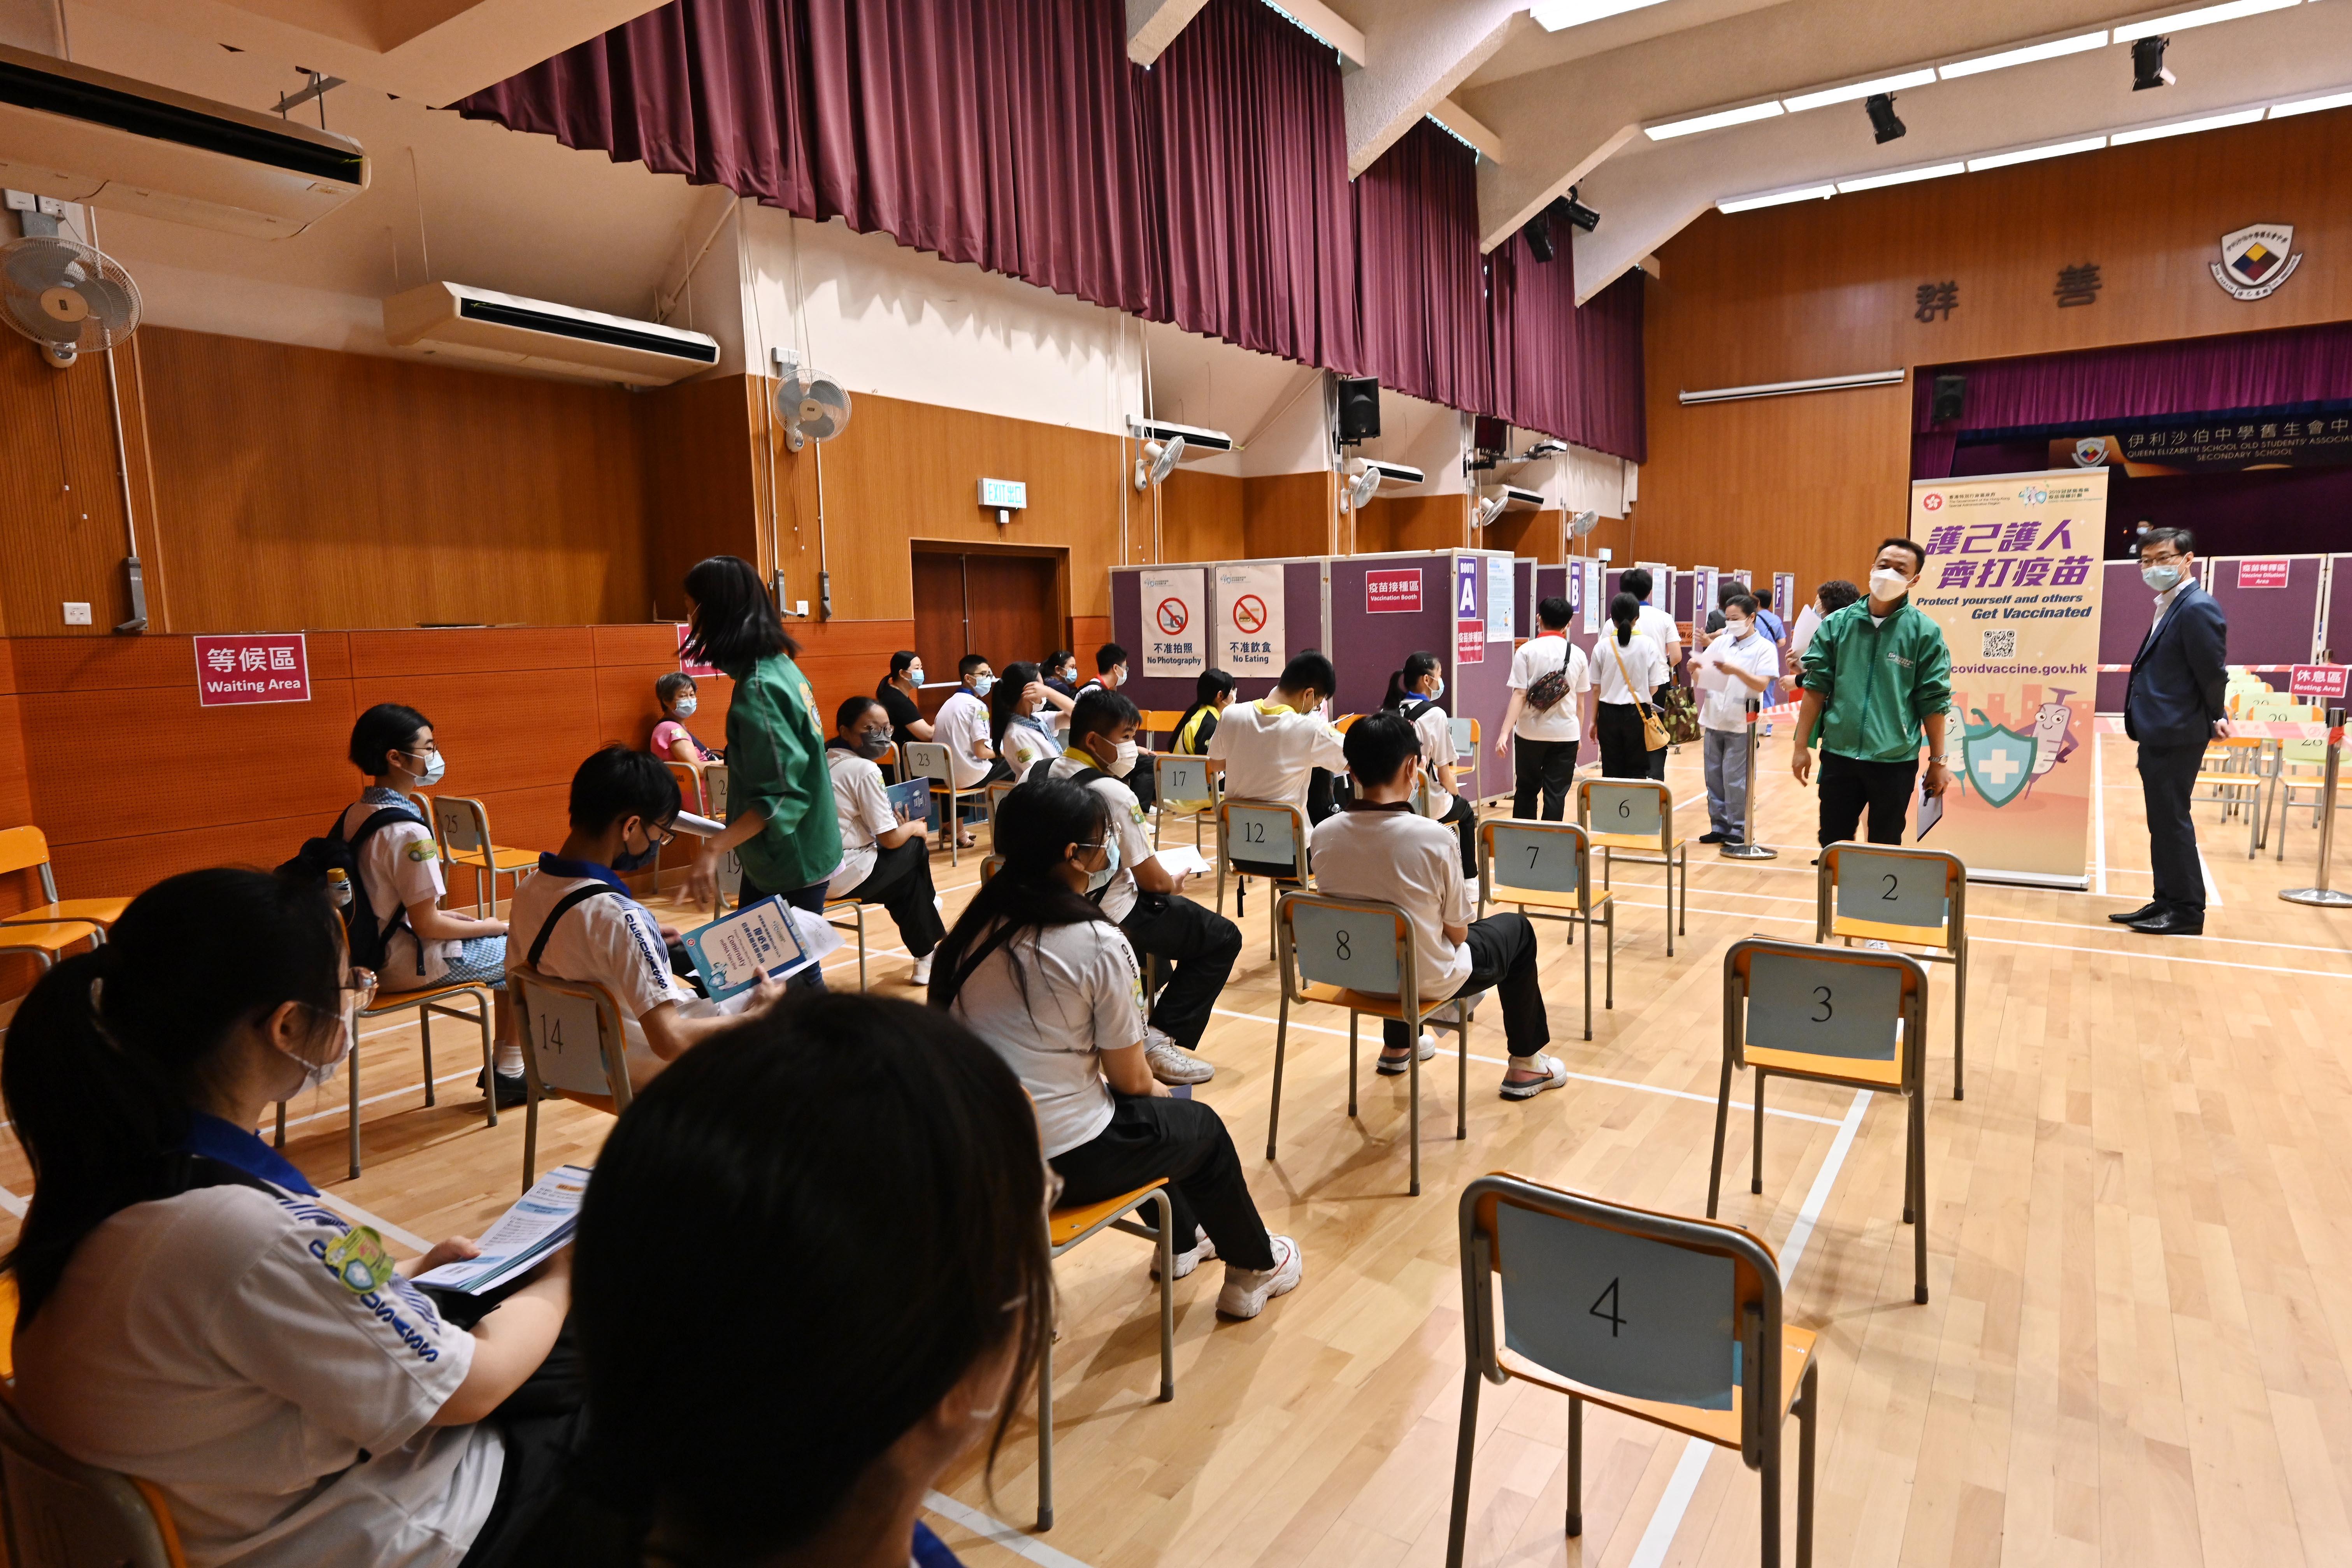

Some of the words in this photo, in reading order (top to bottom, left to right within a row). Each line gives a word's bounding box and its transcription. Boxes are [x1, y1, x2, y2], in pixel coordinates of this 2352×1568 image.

[2127, 449, 2155, 458] QUEEN
[2157, 446, 2199, 456] ELIZABETH
[2201, 443, 2237, 452] SCHOOL
[2197, 451, 2251, 462] SECONDARY
[2254, 448, 2293, 457] SCHOOL
[988, 483, 1006, 502] EXIT
[1007, 485, 1022, 504] 出口
[1925, 519, 2072, 556] 護己護人
[1460, 562, 1474, 574] BOOTH
[1936, 555, 2094, 589] 齊打疫苗
[1368, 580, 1420, 593] 疫苗接種區
[1459, 578, 1475, 611] A
[1571, 578, 1579, 606] B
[1697, 584, 1703, 606] D
[1776, 586, 1781, 604] F
[1916, 597, 1959, 606] Protect
[1961, 595, 2012, 606] yourself
[2014, 594, 2039, 604] and
[2041, 594, 2083, 603] others
[1971, 608, 1999, 619] Get
[2003, 606, 2092, 619] Vaccinated
[1458, 631, 1483, 643] 疫苗接種區
[1154, 643, 1193, 654] 不准拍照
[1230, 642, 1271, 653] 不准飲食
[207, 647, 297, 673] 等候區
[1157, 657, 1201, 665] Photography
[1245, 655, 1269, 664] Eating
[1951, 664, 2088, 675] covidvaccine.gov.hk
[2296, 669, 2343, 684] 休息區
[207, 680, 265, 693] Waiting
[269, 679, 301, 690] Area
[2294, 683, 2321, 692] Resting
[917, 753, 930, 767] 23
[1172, 771, 1187, 787] 17
[1619, 799, 1631, 819] 6
[444, 815, 458, 834] 25
[1246, 822, 1266, 843] 12
[727, 851, 741, 874] 19
[1526, 846, 1539, 869] 7
[1882, 874, 1899, 901] 2
[719, 939, 729, 953] mRNA
[726, 952, 737, 971] Vaccine
[727, 935, 746, 967] Comirnaty
[1336, 929, 1352, 962] 8
[1811, 985, 1833, 1023] 3
[541, 1013, 564, 1055] 14
[1589, 1277, 1627, 1337] 4
